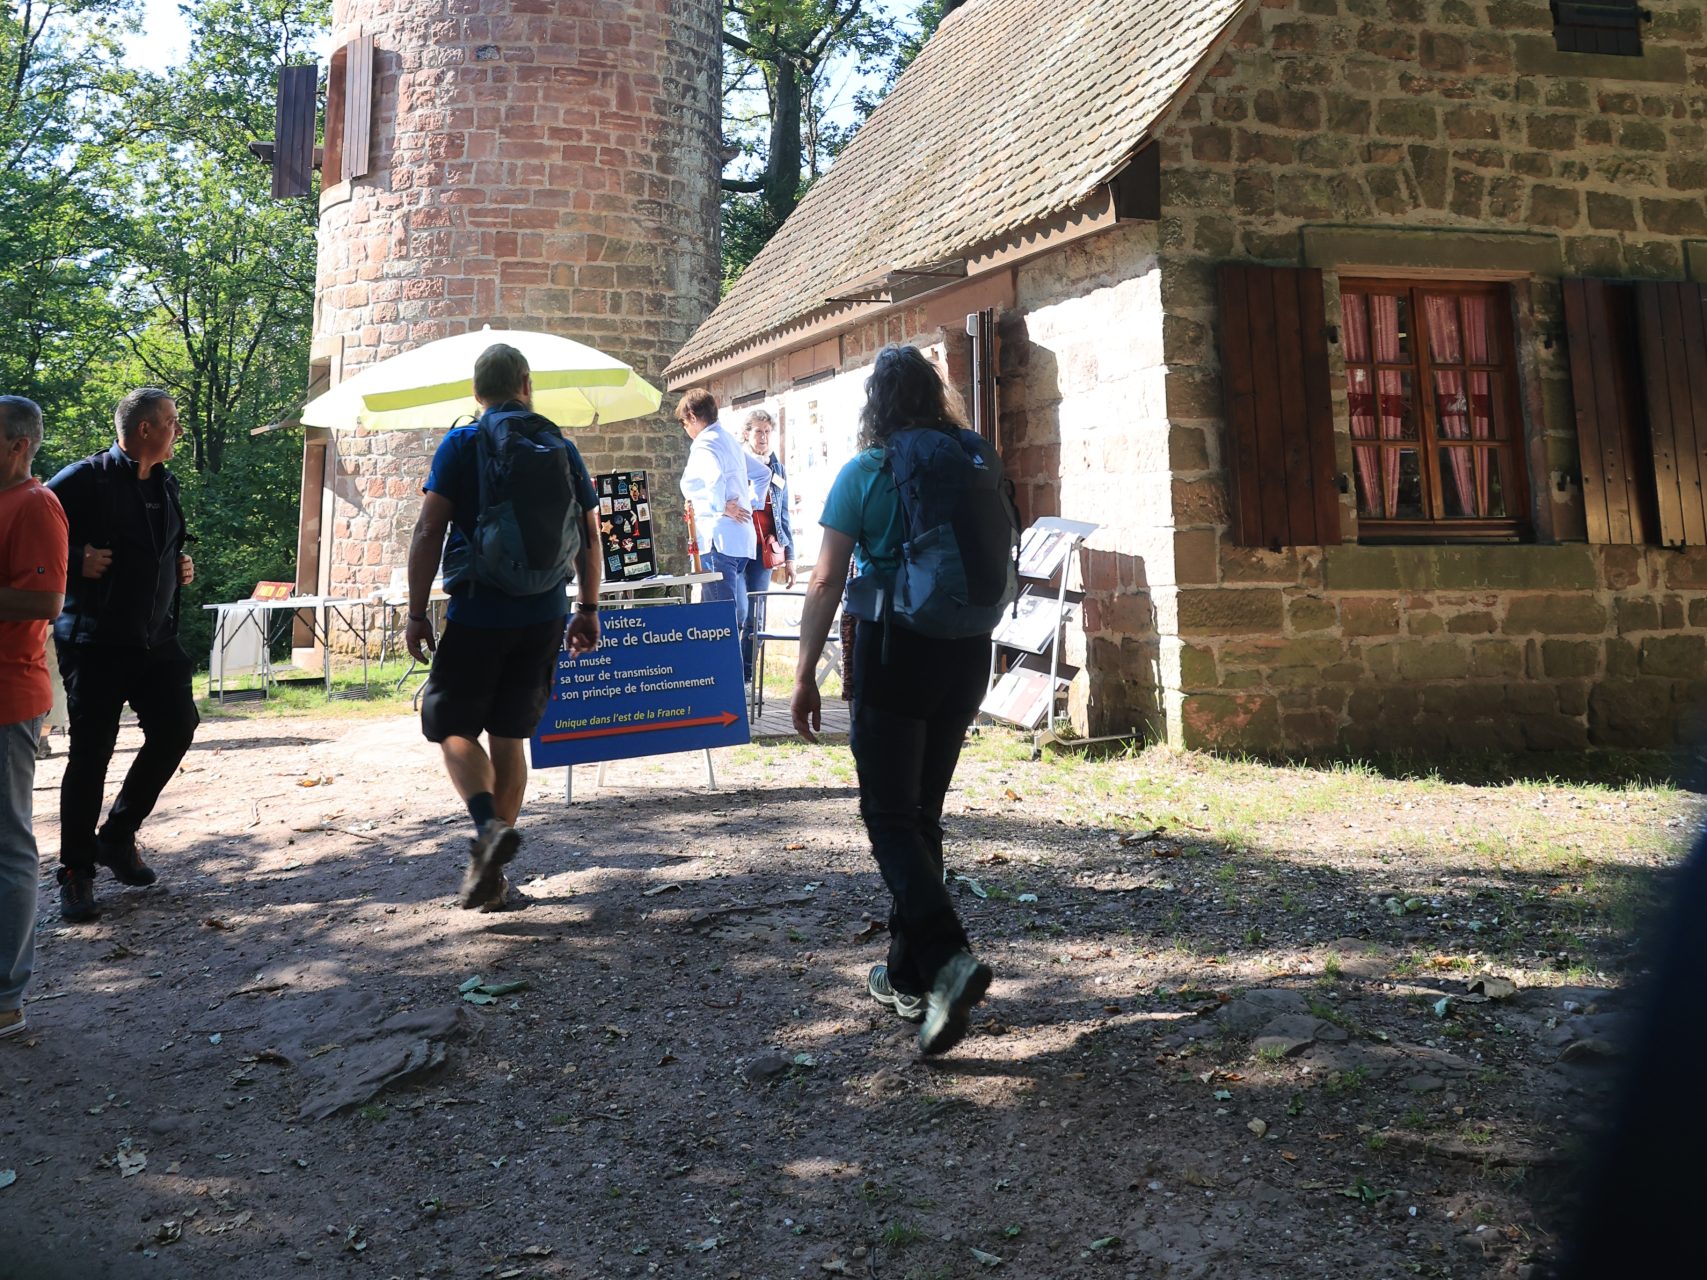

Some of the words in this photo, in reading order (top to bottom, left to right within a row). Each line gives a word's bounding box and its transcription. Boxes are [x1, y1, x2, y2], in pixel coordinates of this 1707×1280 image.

[604, 616, 646, 630] visitez,
[622, 633, 638, 645] de
[642, 629, 683, 644] Claude
[686, 627, 731, 642] Chappe
[559, 660, 576, 669] son
[580, 656, 612, 666] musée
[560, 676, 571, 684] sa
[574, 673, 595, 682] tour
[598, 670, 611, 680] de
[614, 664, 673, 679] transmission
[561, 691, 579, 700] son
[582, 684, 622, 700] principe
[624, 682, 637, 694] de
[640, 676, 716, 692] fonctionnement
[554, 718, 588, 729] Unique
[590, 716, 611, 725] dans
[633, 710, 645, 720] de
[647, 709, 655, 718] la
[657, 708, 686, 718] France
